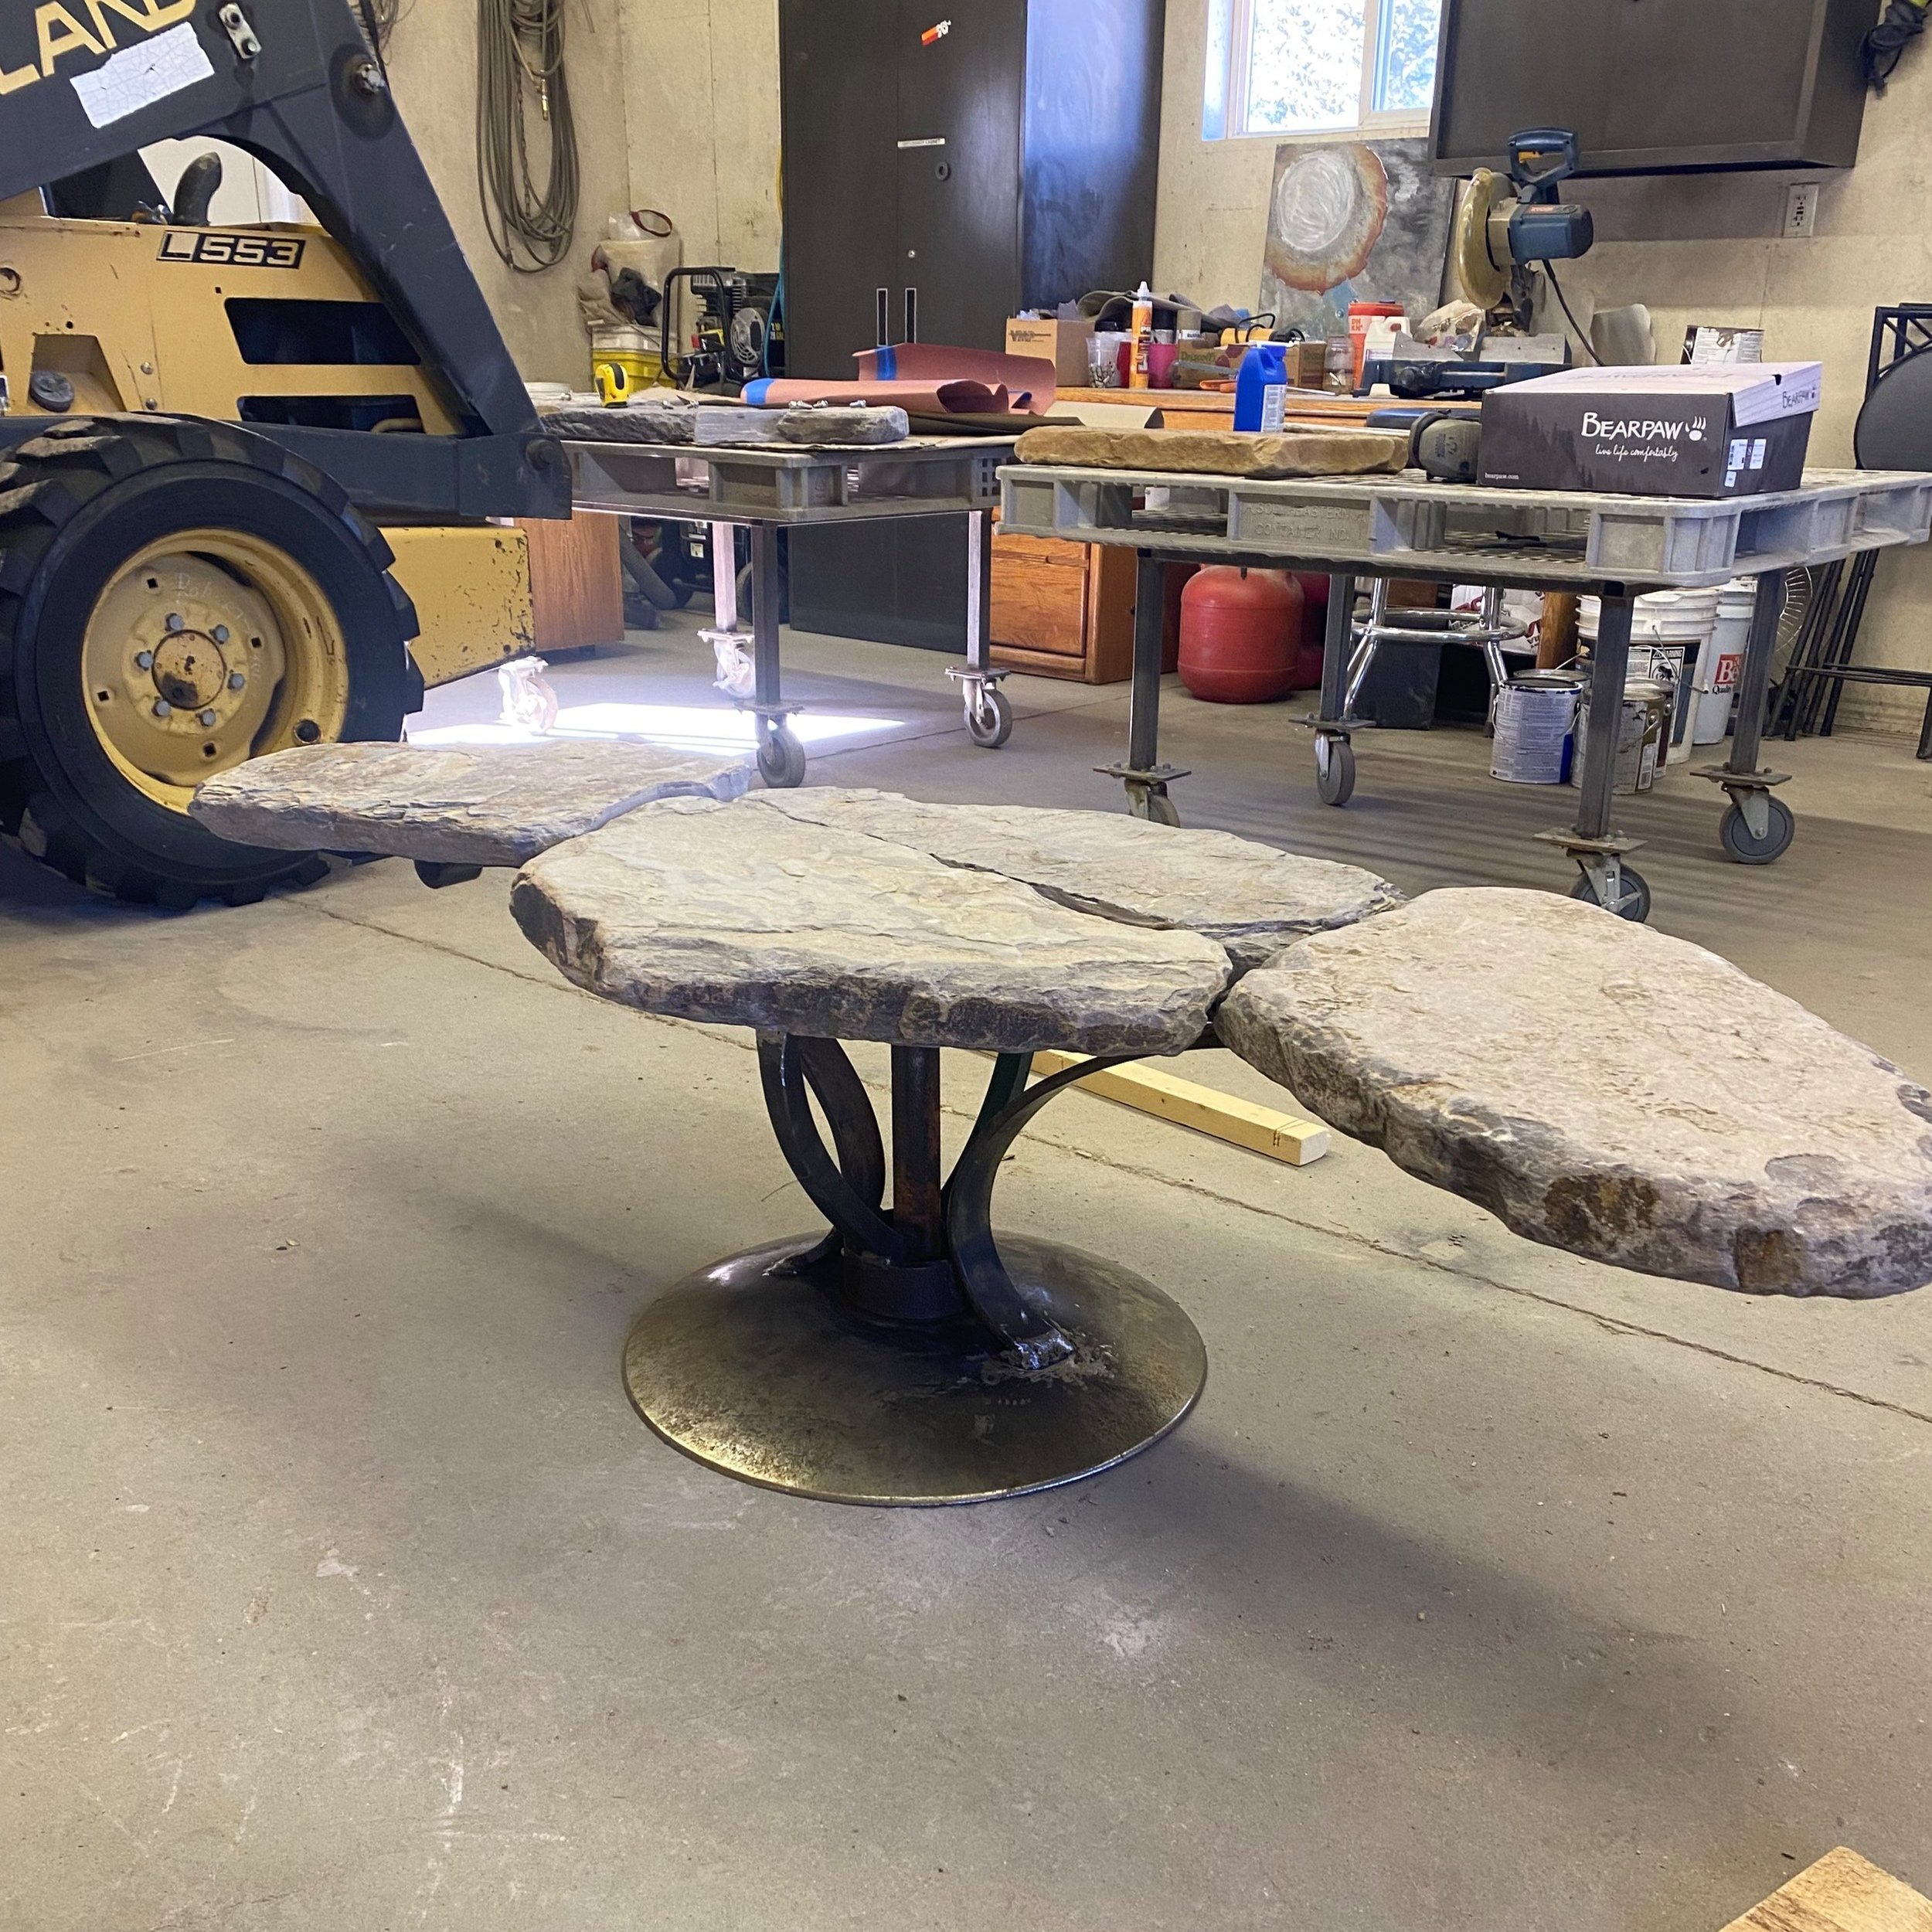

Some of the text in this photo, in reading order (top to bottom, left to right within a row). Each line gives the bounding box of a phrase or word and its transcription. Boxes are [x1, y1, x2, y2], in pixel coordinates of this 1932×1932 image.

[157, 231, 302, 268] L553
[1581, 412, 1684, 440] BEARPAW
[1595, 444, 1679, 462] live life comfortably
